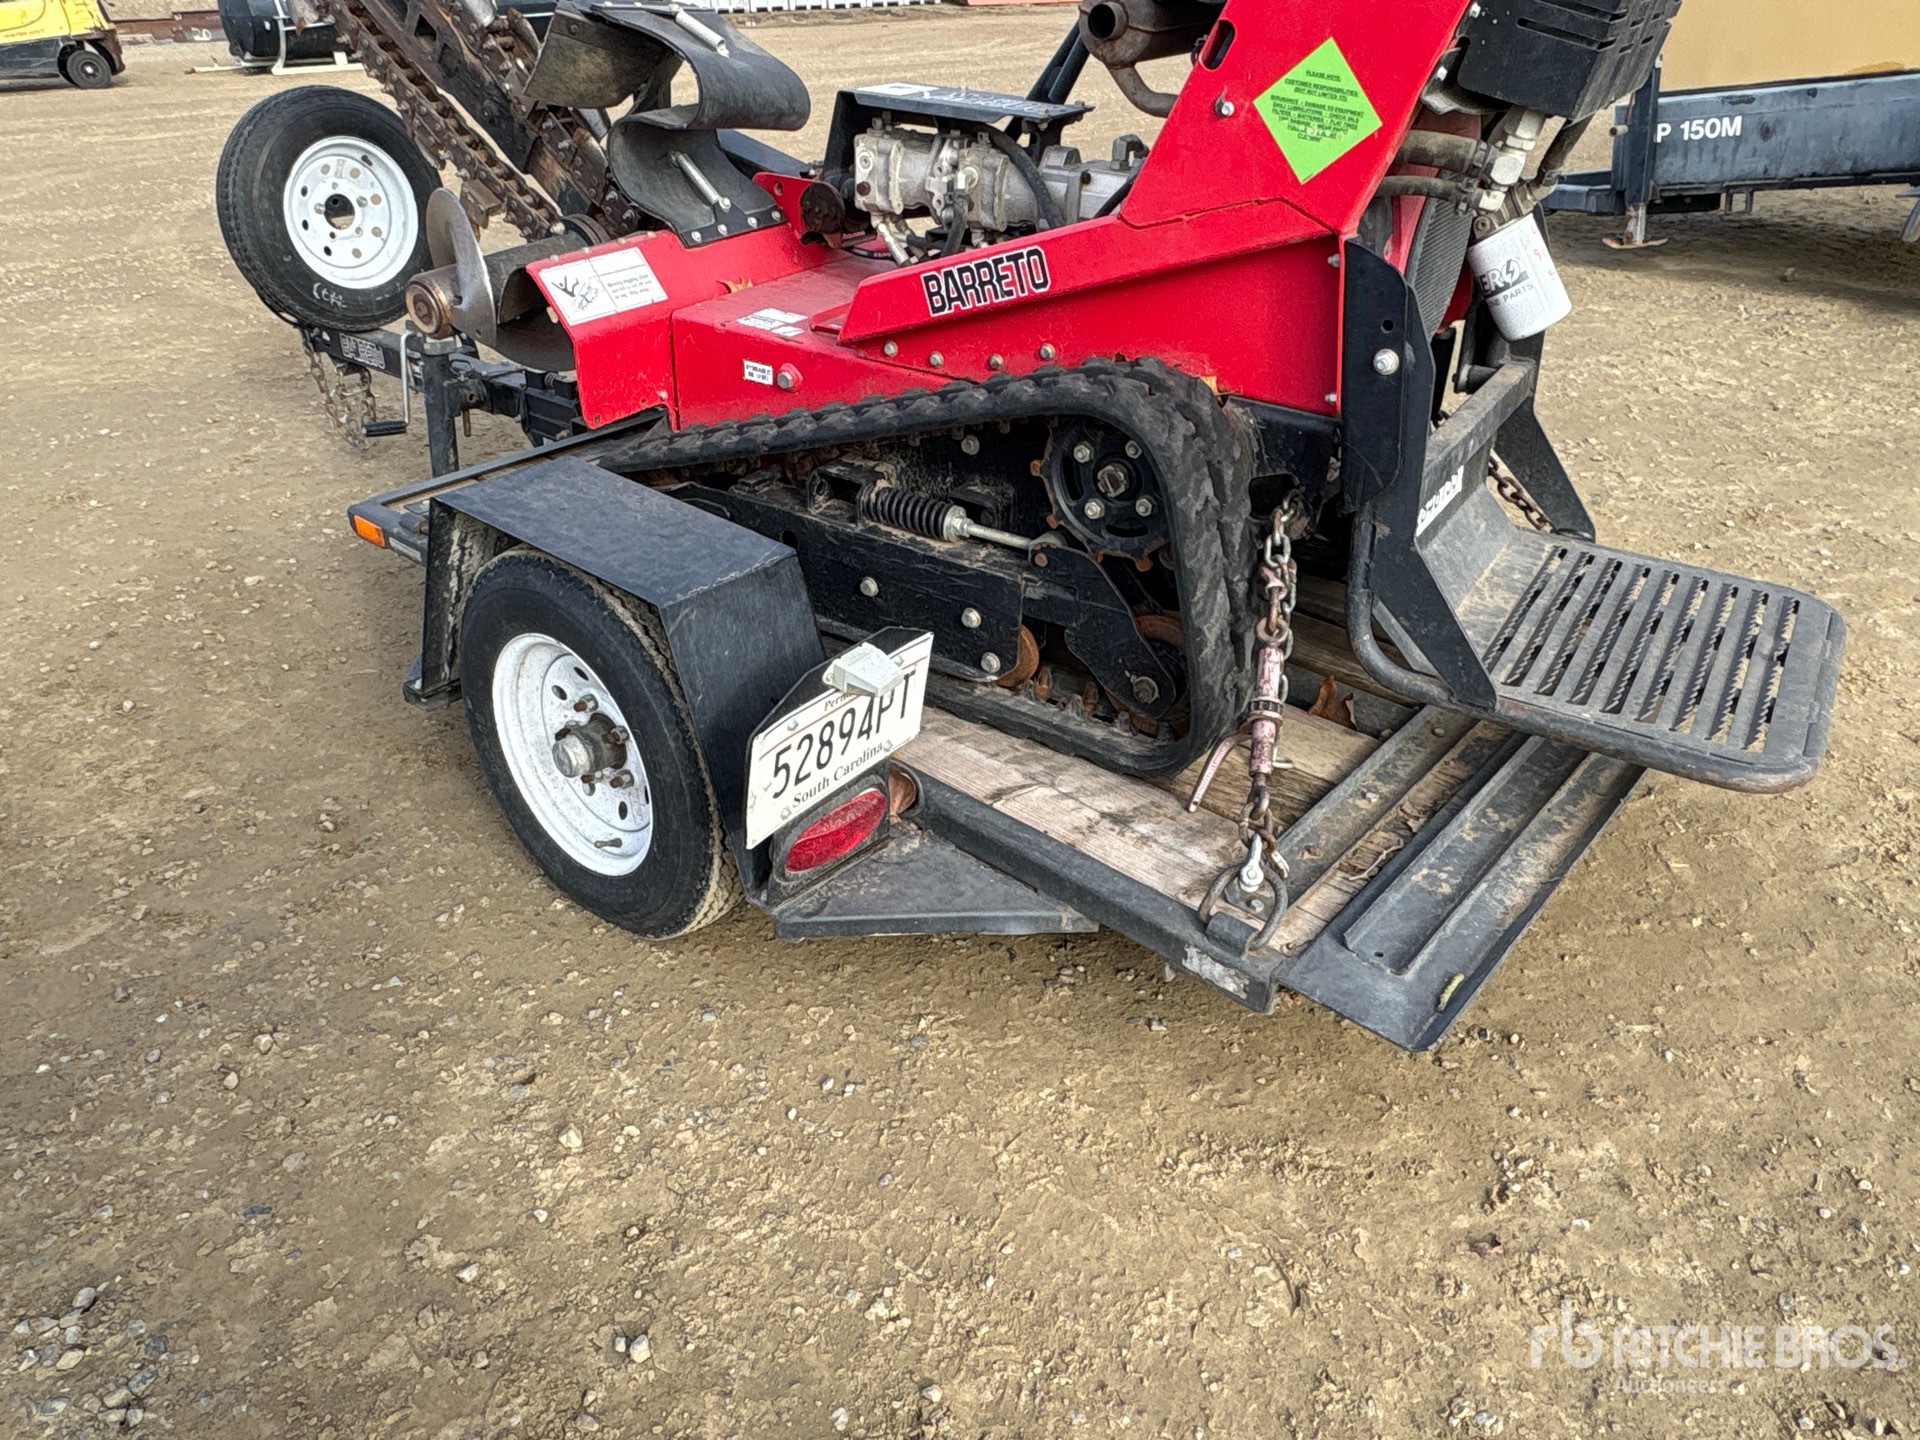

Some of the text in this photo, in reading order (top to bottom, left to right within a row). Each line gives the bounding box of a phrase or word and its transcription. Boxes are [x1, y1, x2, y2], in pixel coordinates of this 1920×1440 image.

[1680, 116, 1742, 141] 150M
[922, 247, 1050, 315] BARRETO
[1503, 283, 1534, 303] PARTS
[772, 669, 917, 799] 52894PT
[792, 742, 883, 808] South Carolina
